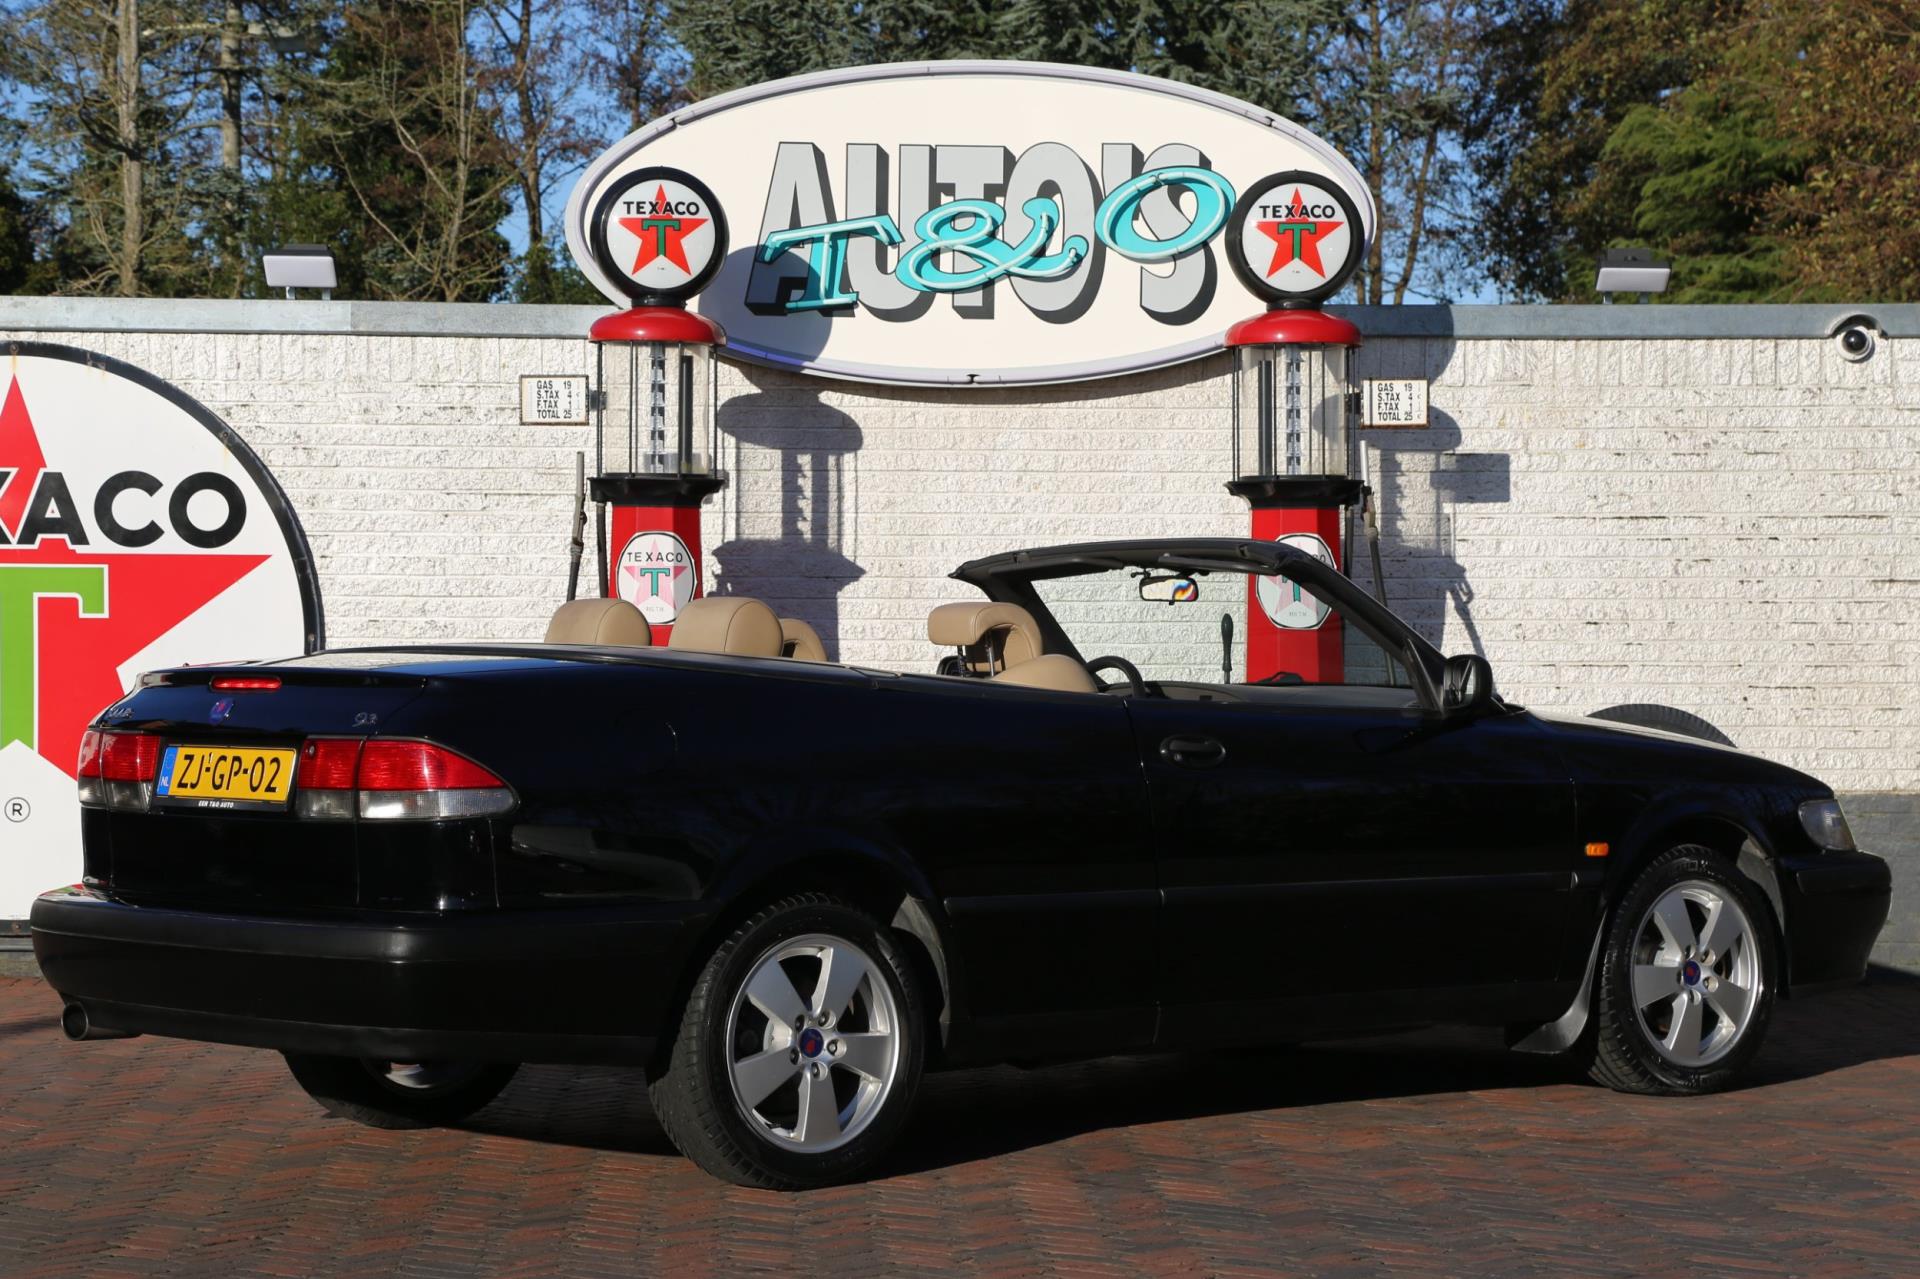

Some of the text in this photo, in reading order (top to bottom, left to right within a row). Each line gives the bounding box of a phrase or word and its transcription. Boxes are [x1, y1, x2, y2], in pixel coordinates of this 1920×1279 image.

[623, 201, 699, 216] TEXACO
[1259, 204, 1336, 219] TEXACO
[641, 219, 681, 257] T
[744, 141, 1217, 324] AUTO'S
[1277, 222, 1317, 260] T
[537, 380, 553, 390] GAS
[1378, 382, 1394, 392] GAS
[537, 390, 572, 399] S.TAX 4
[1378, 392, 1413, 402] S.TAX 4
[537, 400, 558, 409] F.TAX
[1378, 402, 1399, 411] F.TAX
[537, 410, 572, 419] TOTAL 25
[1378, 412, 1413, 421] TOTAL 25
[0, 471, 247, 549] ACO
[627, 552, 683, 563] TEXACO
[640, 567, 671, 597] T
[177, 753, 281, 793] ZJ-GP-02
[160, 775, 169, 787] NL
[220, 801, 234, 809] AUTO
